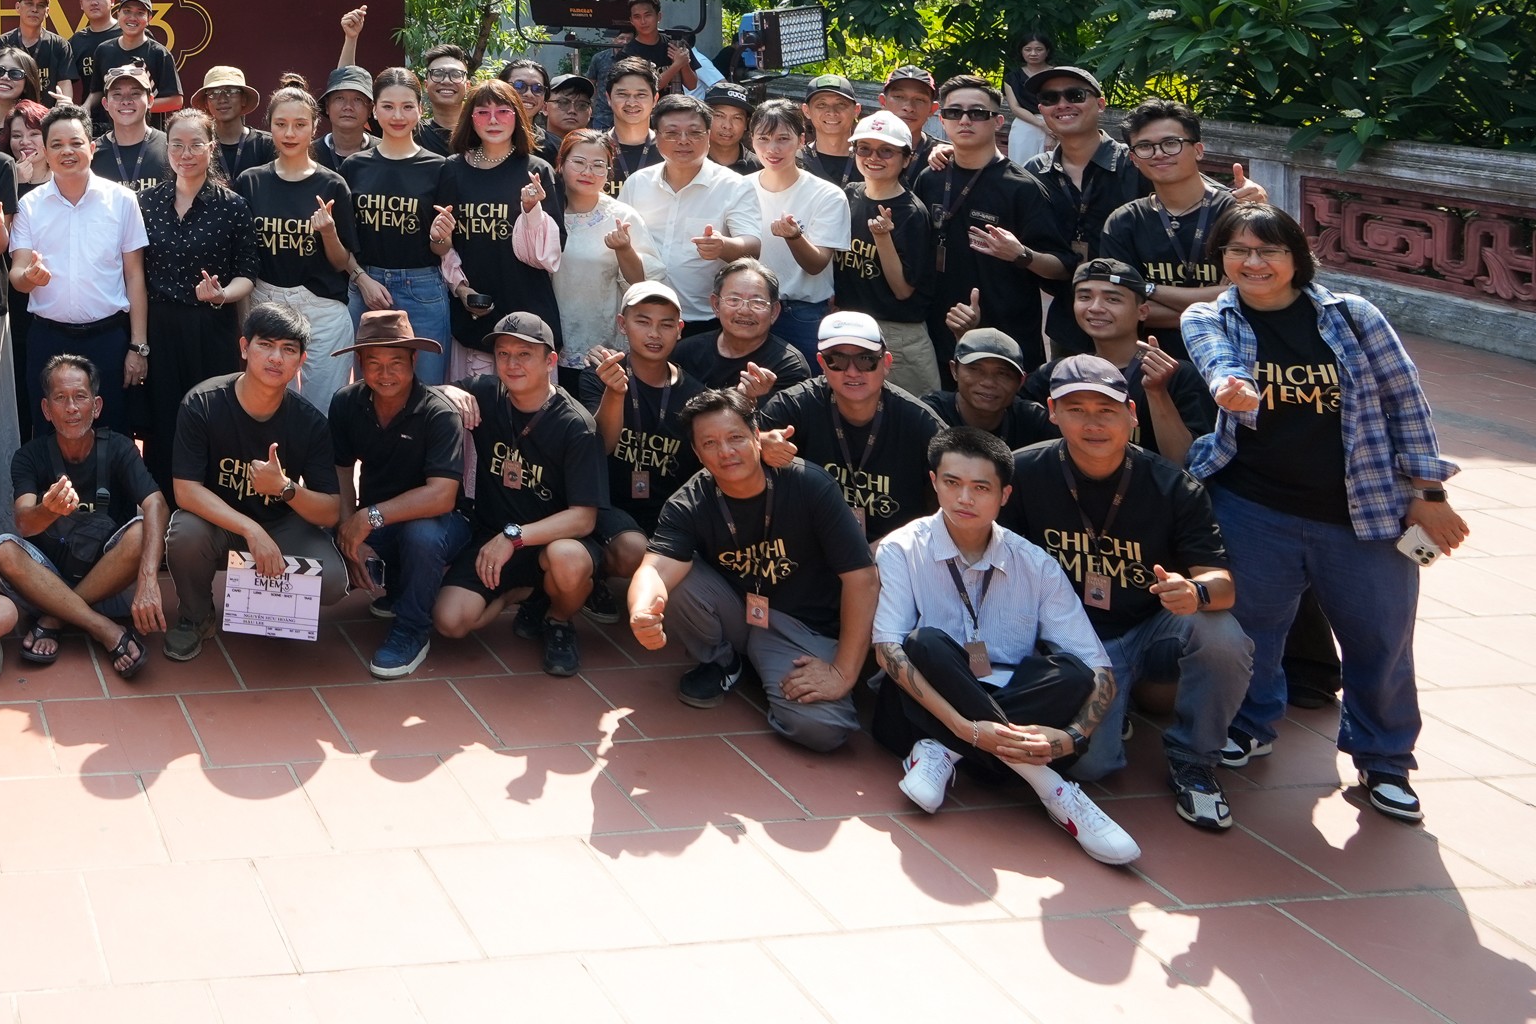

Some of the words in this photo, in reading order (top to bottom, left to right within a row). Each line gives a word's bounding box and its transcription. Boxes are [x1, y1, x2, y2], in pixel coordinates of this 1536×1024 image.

[382, 211, 406, 235] EM
[408, 218, 416, 230] 3
[471, 218, 497, 241] EM
[499, 224, 508, 236] 3
[279, 234, 304, 257] EM
[306, 241, 314, 252] 3
[865, 263, 874, 276] 3
[1252, 361, 1283, 386] HỊ
[1280, 385, 1323, 414] EM
[1330, 392, 1341, 407] 3
[218, 472, 245, 501] EM
[880, 499, 891, 514] 3
[780, 563, 791, 577] 3
[1133, 568, 1146, 584] 3
